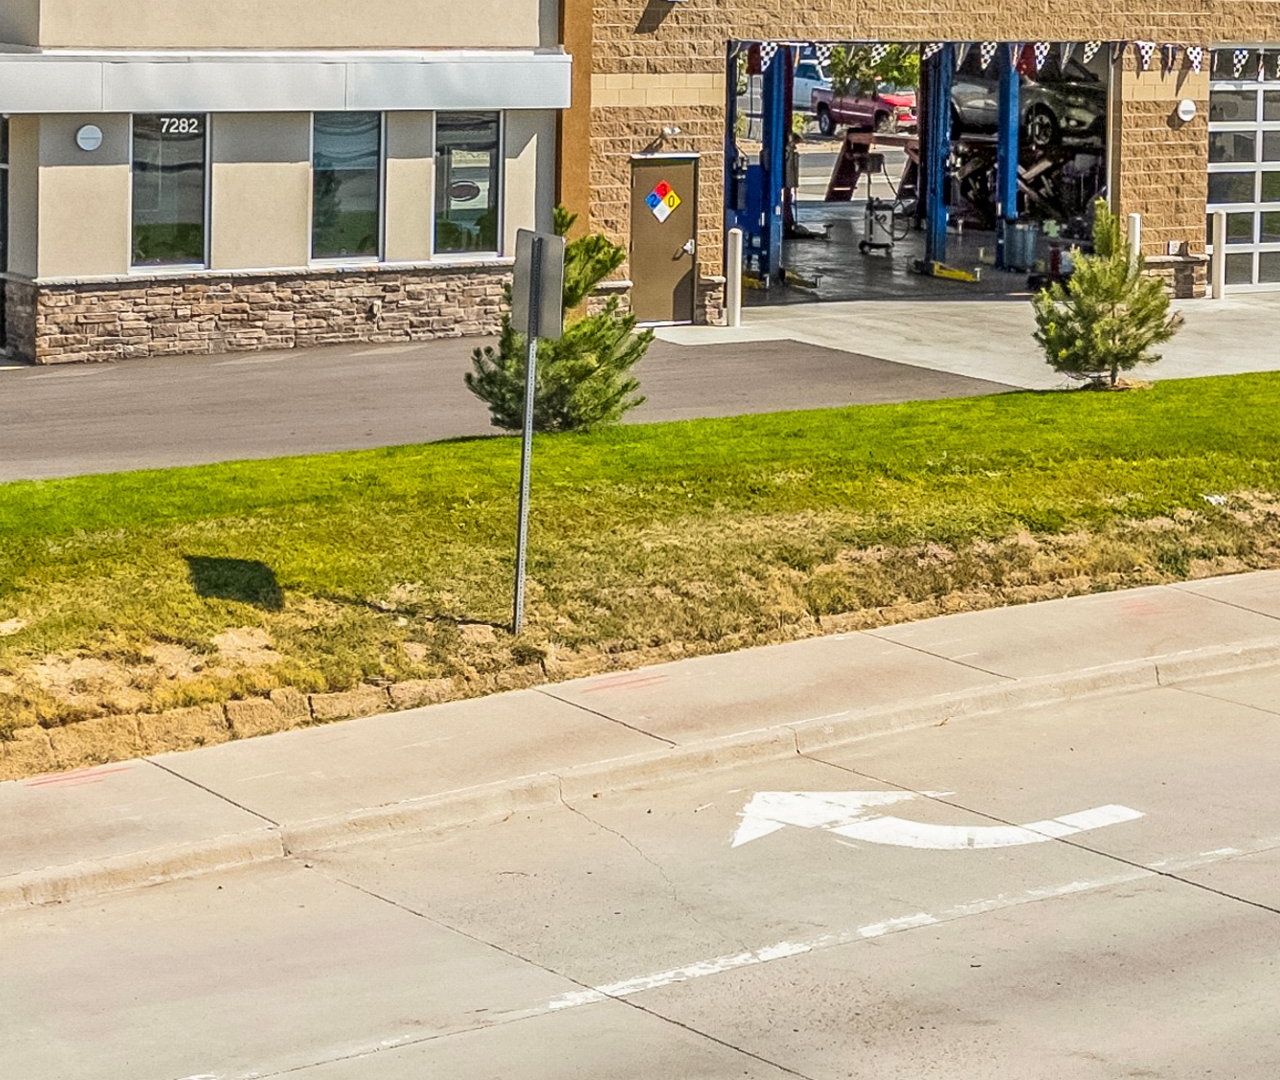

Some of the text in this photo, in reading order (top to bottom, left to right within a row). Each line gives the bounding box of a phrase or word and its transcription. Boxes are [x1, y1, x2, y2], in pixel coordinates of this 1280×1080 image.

[160, 118, 199, 133] 7282
[650, 193, 675, 208] 2 0
